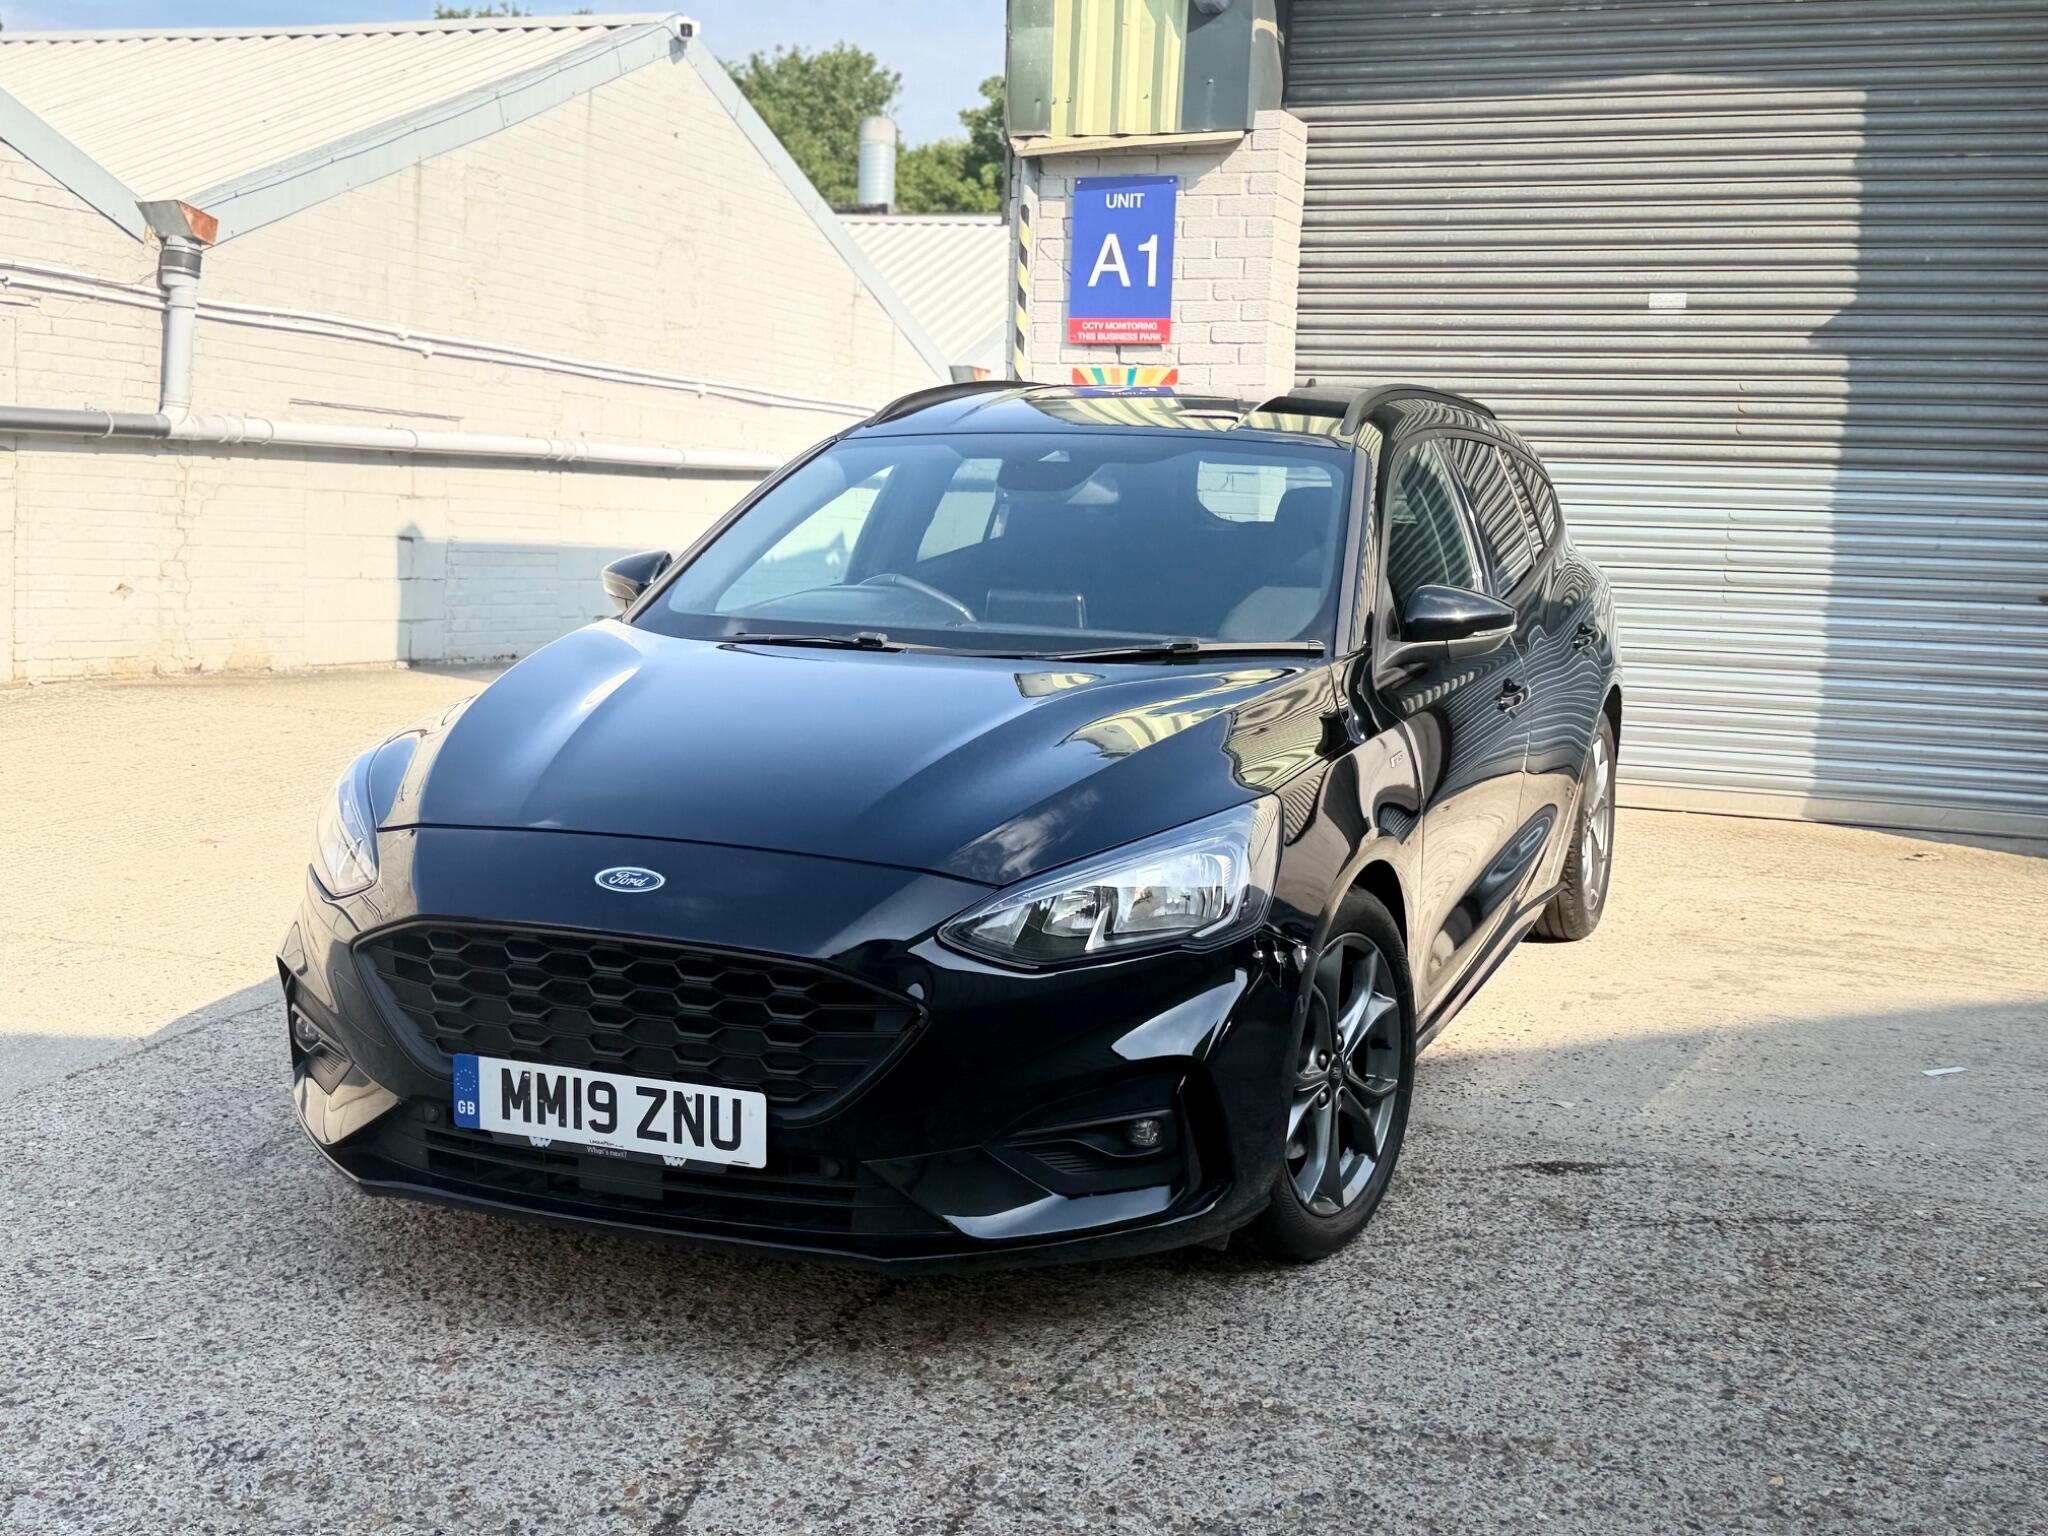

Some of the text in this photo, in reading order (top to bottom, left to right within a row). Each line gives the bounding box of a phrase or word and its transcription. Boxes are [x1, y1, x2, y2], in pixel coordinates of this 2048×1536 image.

[1105, 192, 1145, 208] UNIT
[1087, 233, 1159, 287] A1
[1082, 321, 1157, 330] CCTV MONITORING
[1077, 332, 1161, 341] THIS BUSINESS PARK
[608, 871, 648, 886] Ford
[457, 1100, 476, 1115] GB
[501, 1068, 742, 1151] MM19 ZNU
